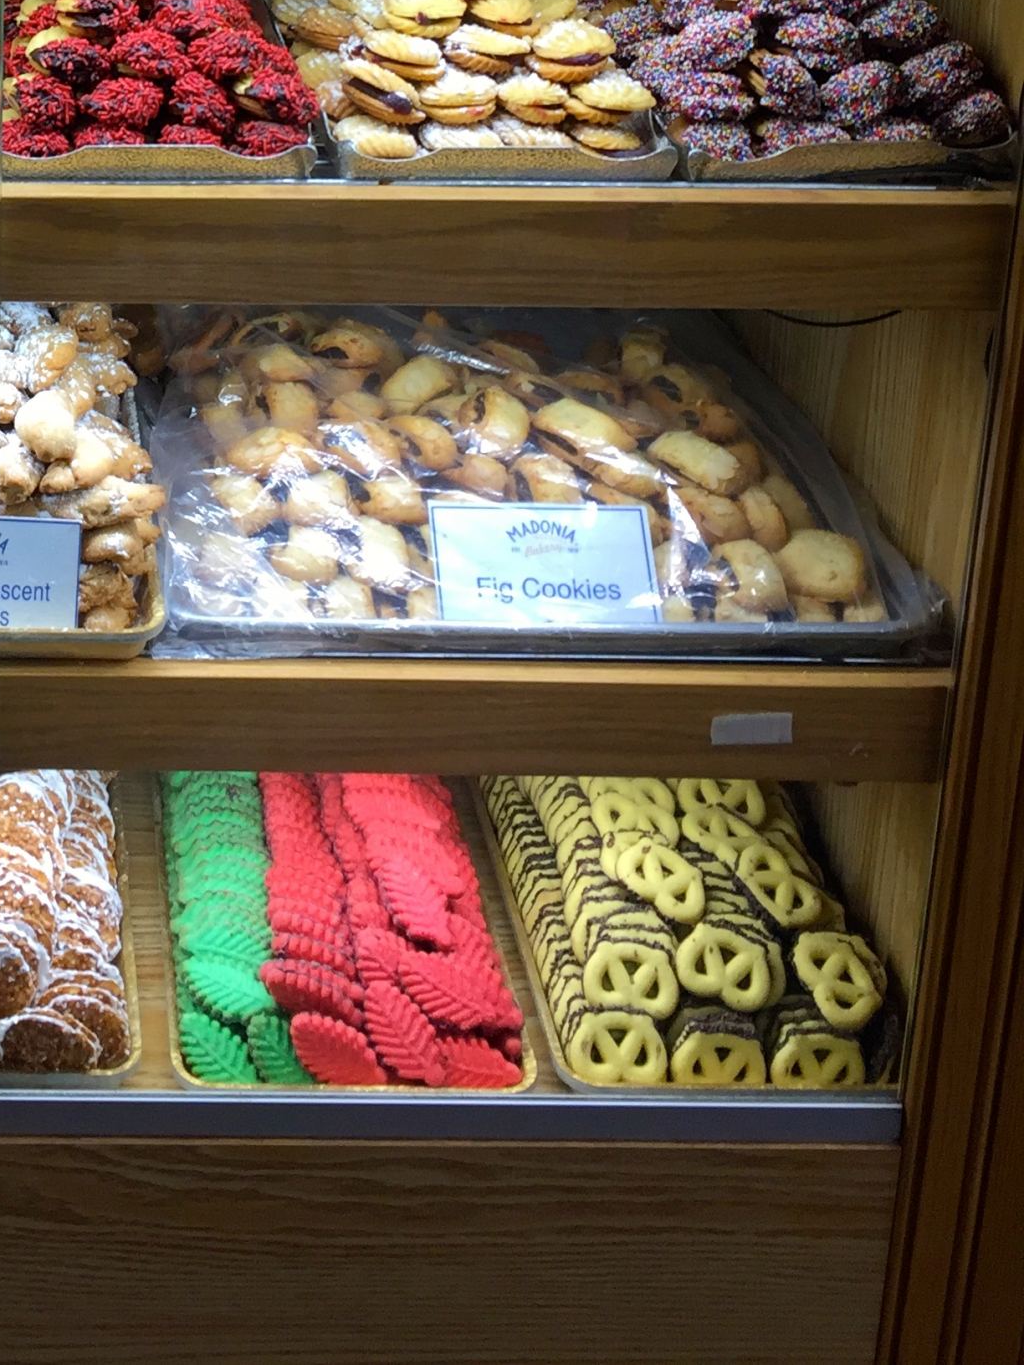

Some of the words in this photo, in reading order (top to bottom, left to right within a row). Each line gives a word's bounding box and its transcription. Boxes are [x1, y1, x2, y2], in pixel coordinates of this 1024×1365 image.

[506, 520, 576, 543] MADONIA
[476, 577, 513, 604] Fig
[522, 577, 621, 600] Cookies
